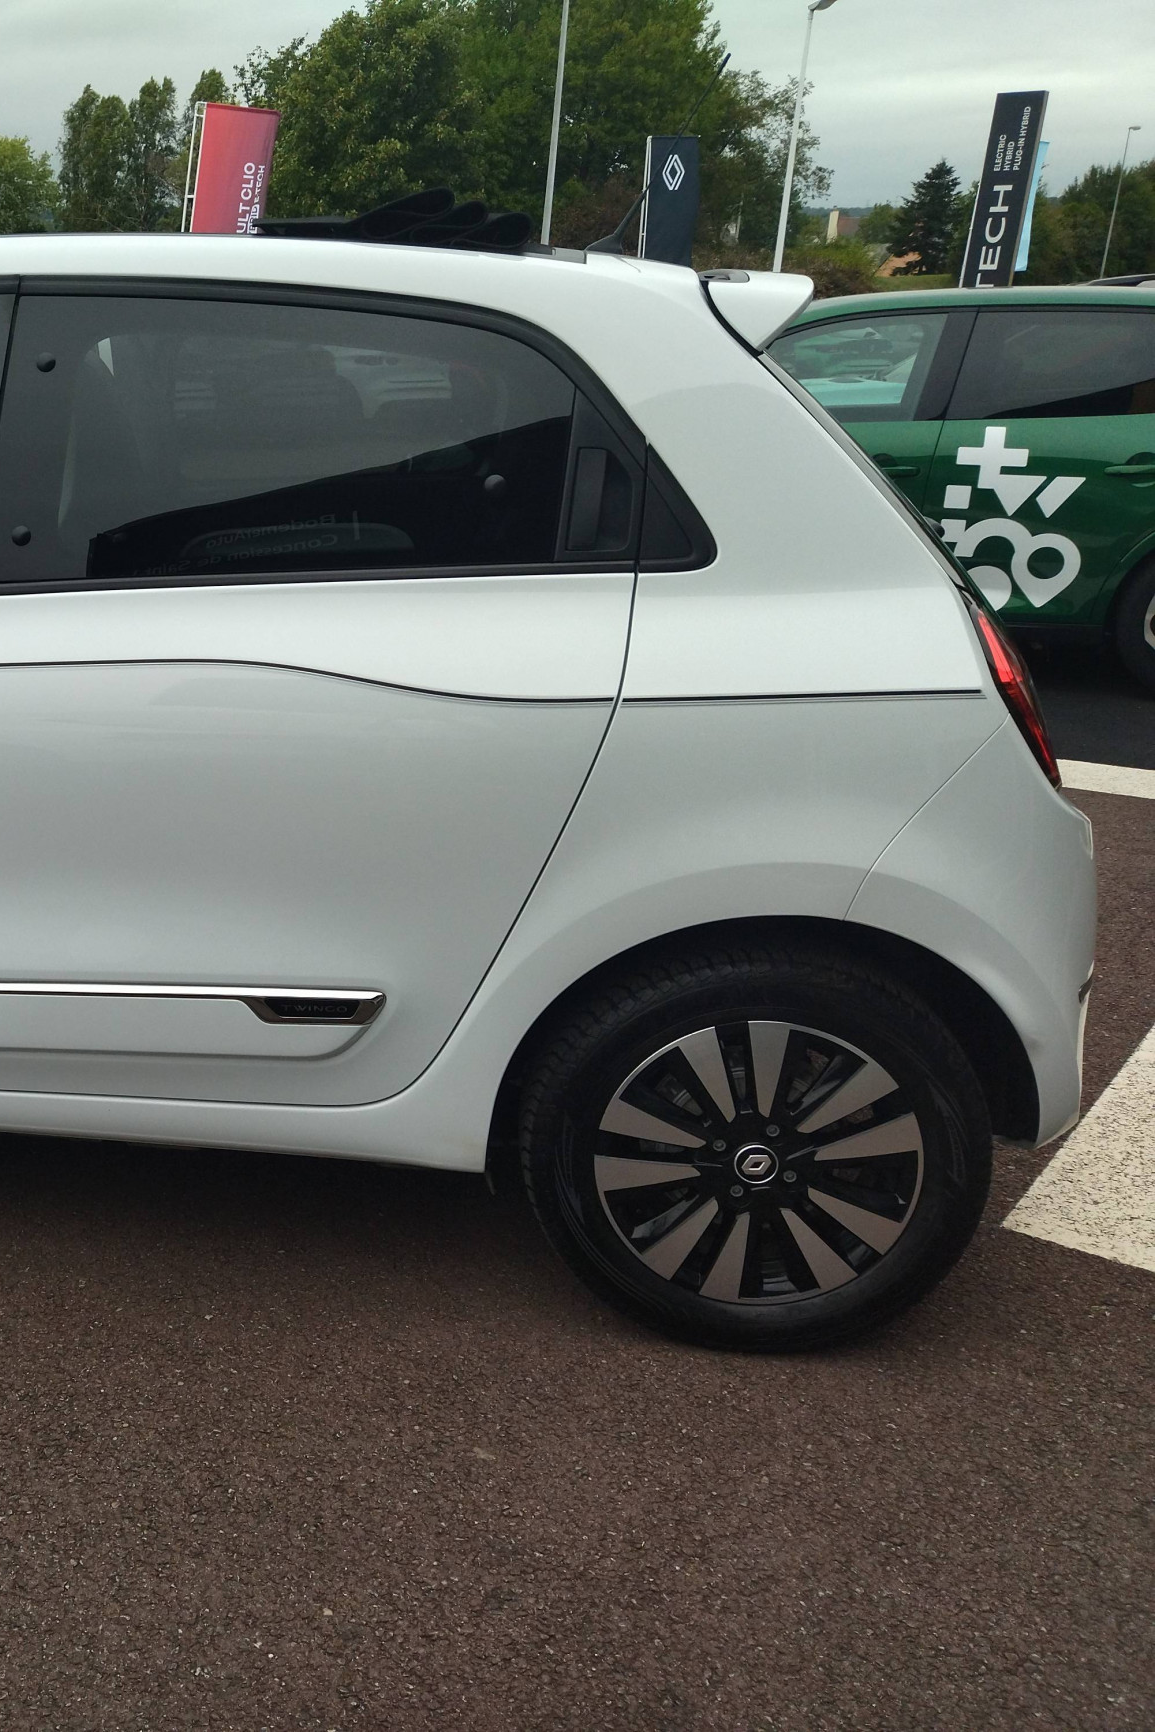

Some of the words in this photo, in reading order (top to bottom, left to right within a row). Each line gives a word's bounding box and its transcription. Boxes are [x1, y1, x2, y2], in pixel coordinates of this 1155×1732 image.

[1019, 106, 1032, 136] HYBRID
[993, 134, 1007, 171] ELECTRIC
[1003, 141, 1015, 171] HYBRID
[1013, 137, 1026, 171] PLUG-IN
[241, 163, 256, 200] CLIO
[280, 1004, 348, 1013] TWINGO
